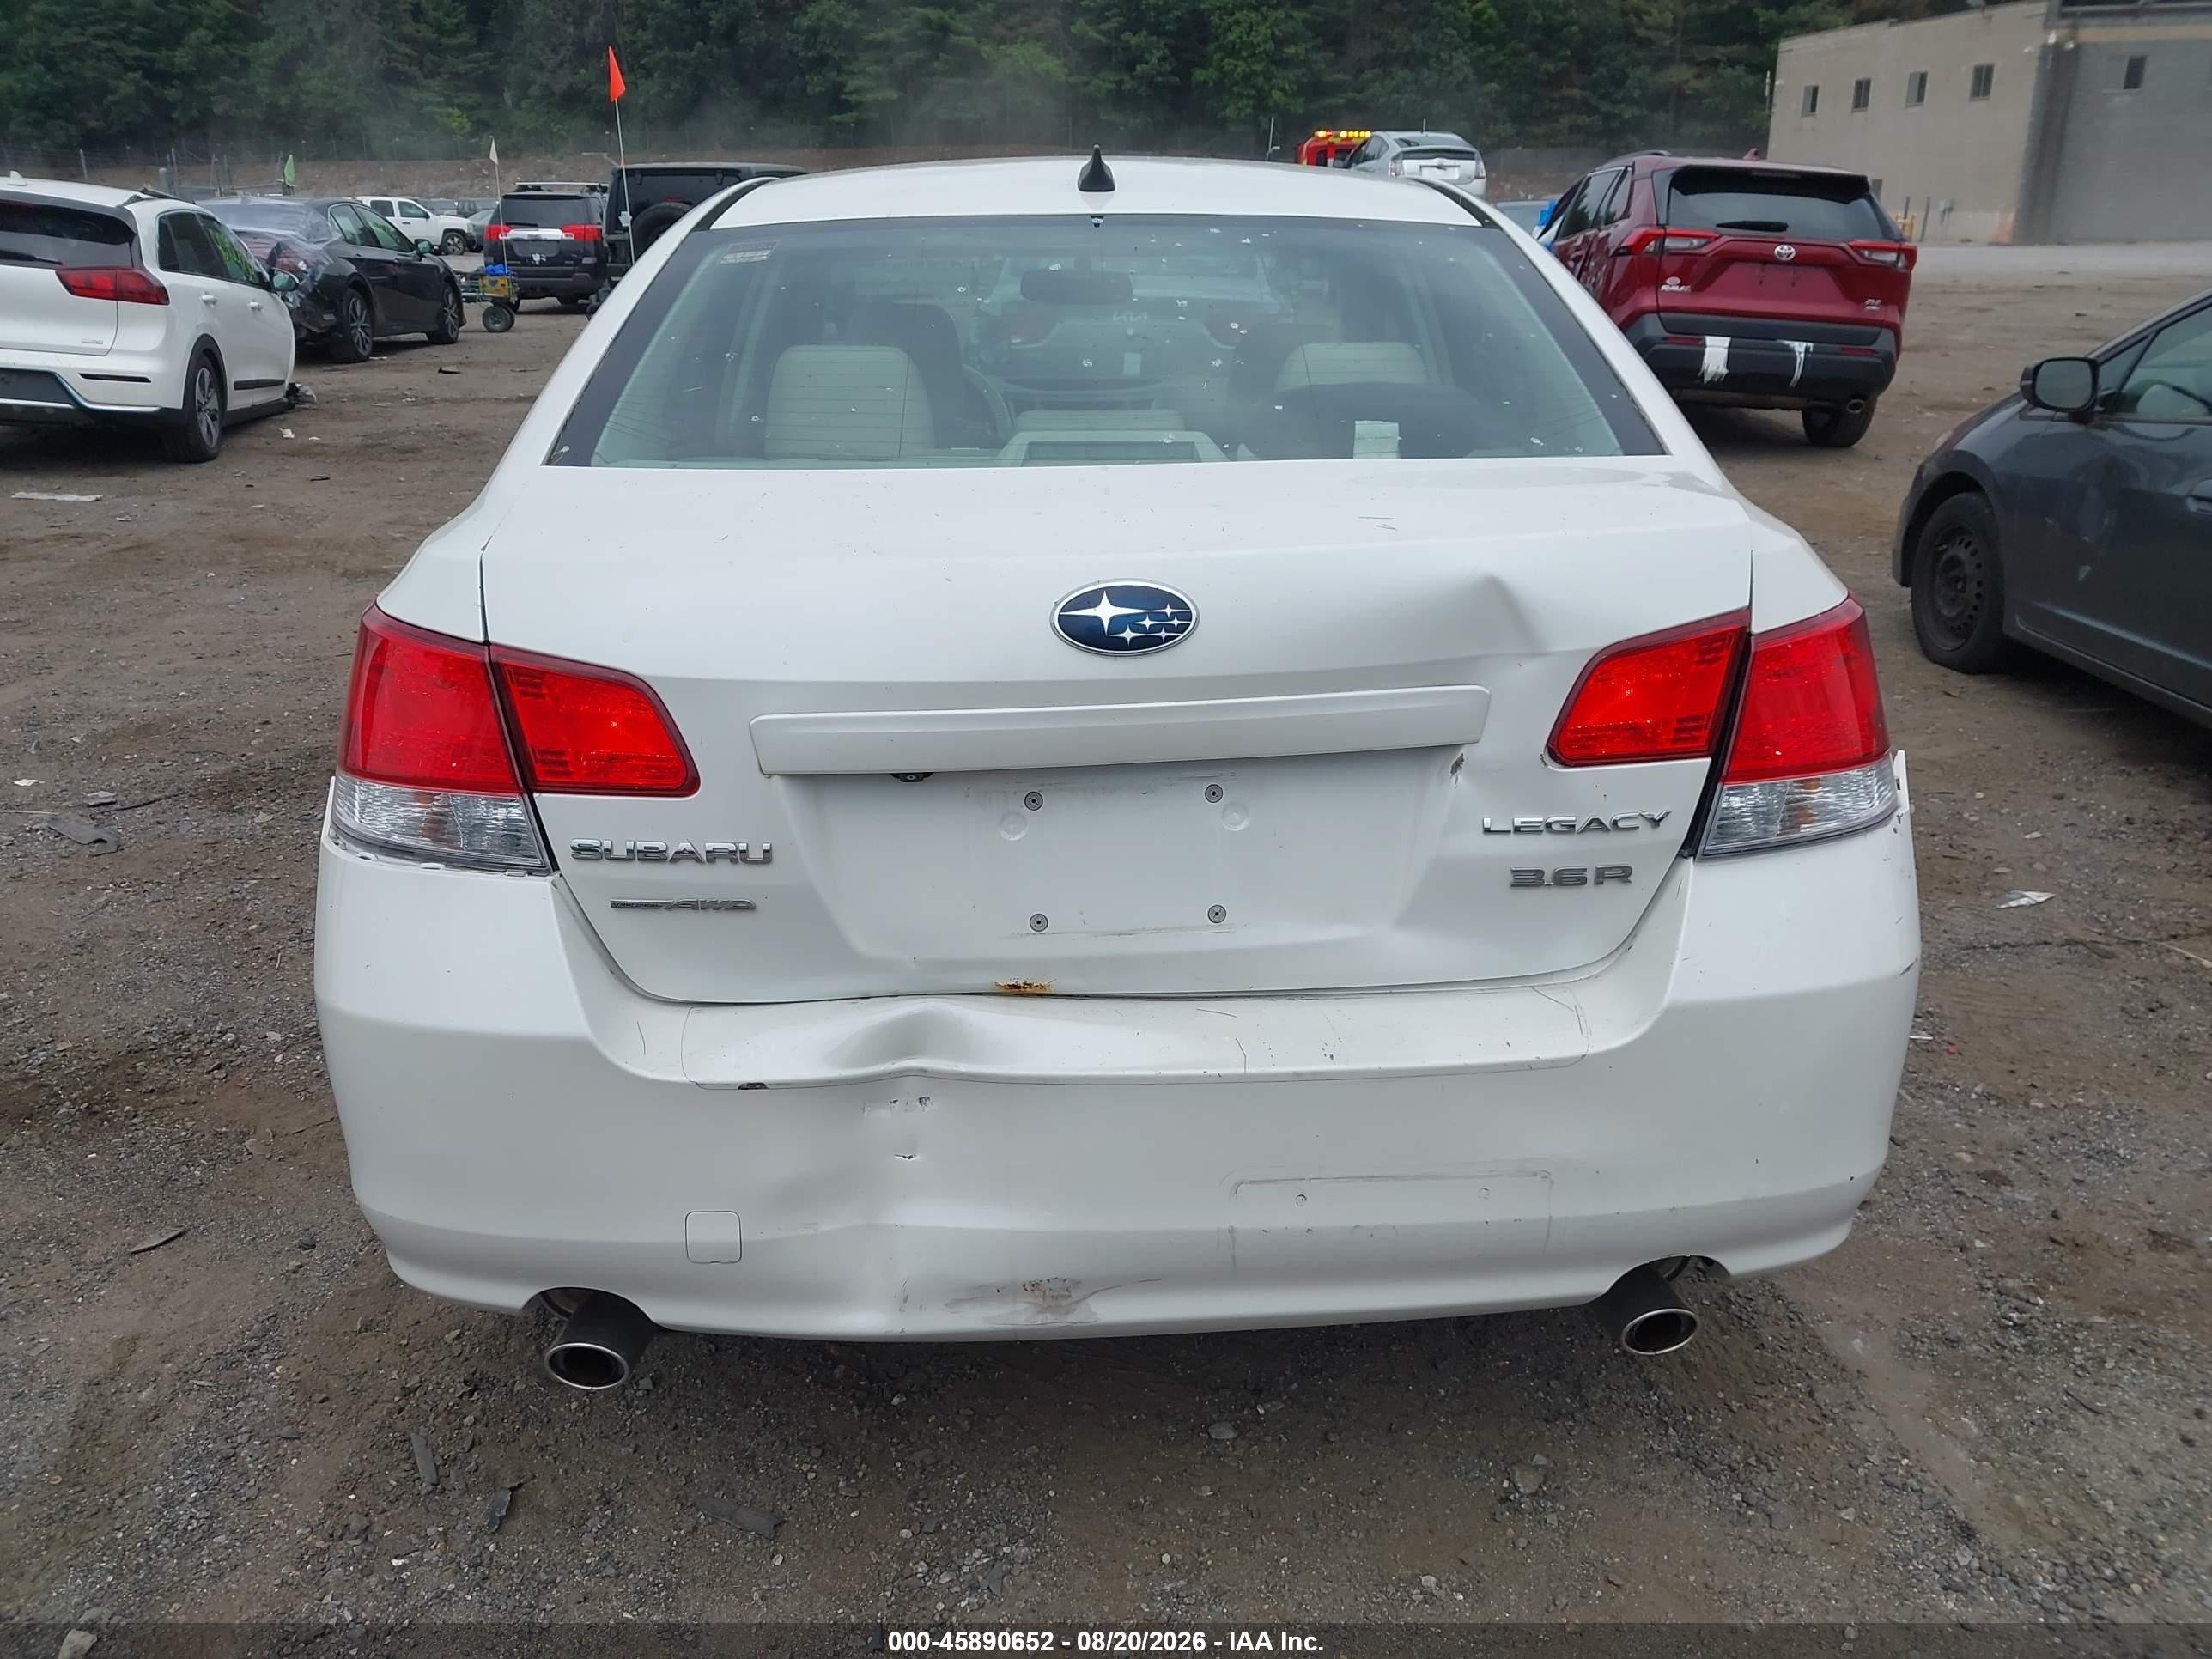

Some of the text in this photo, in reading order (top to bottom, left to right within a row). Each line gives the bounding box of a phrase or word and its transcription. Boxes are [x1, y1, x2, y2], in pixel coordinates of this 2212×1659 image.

[1482, 809, 1672, 835] LEGACY
[570, 838, 773, 865] SUBARU
[1510, 862, 1633, 888] 3.6R
[664, 898, 757, 911] AWD
